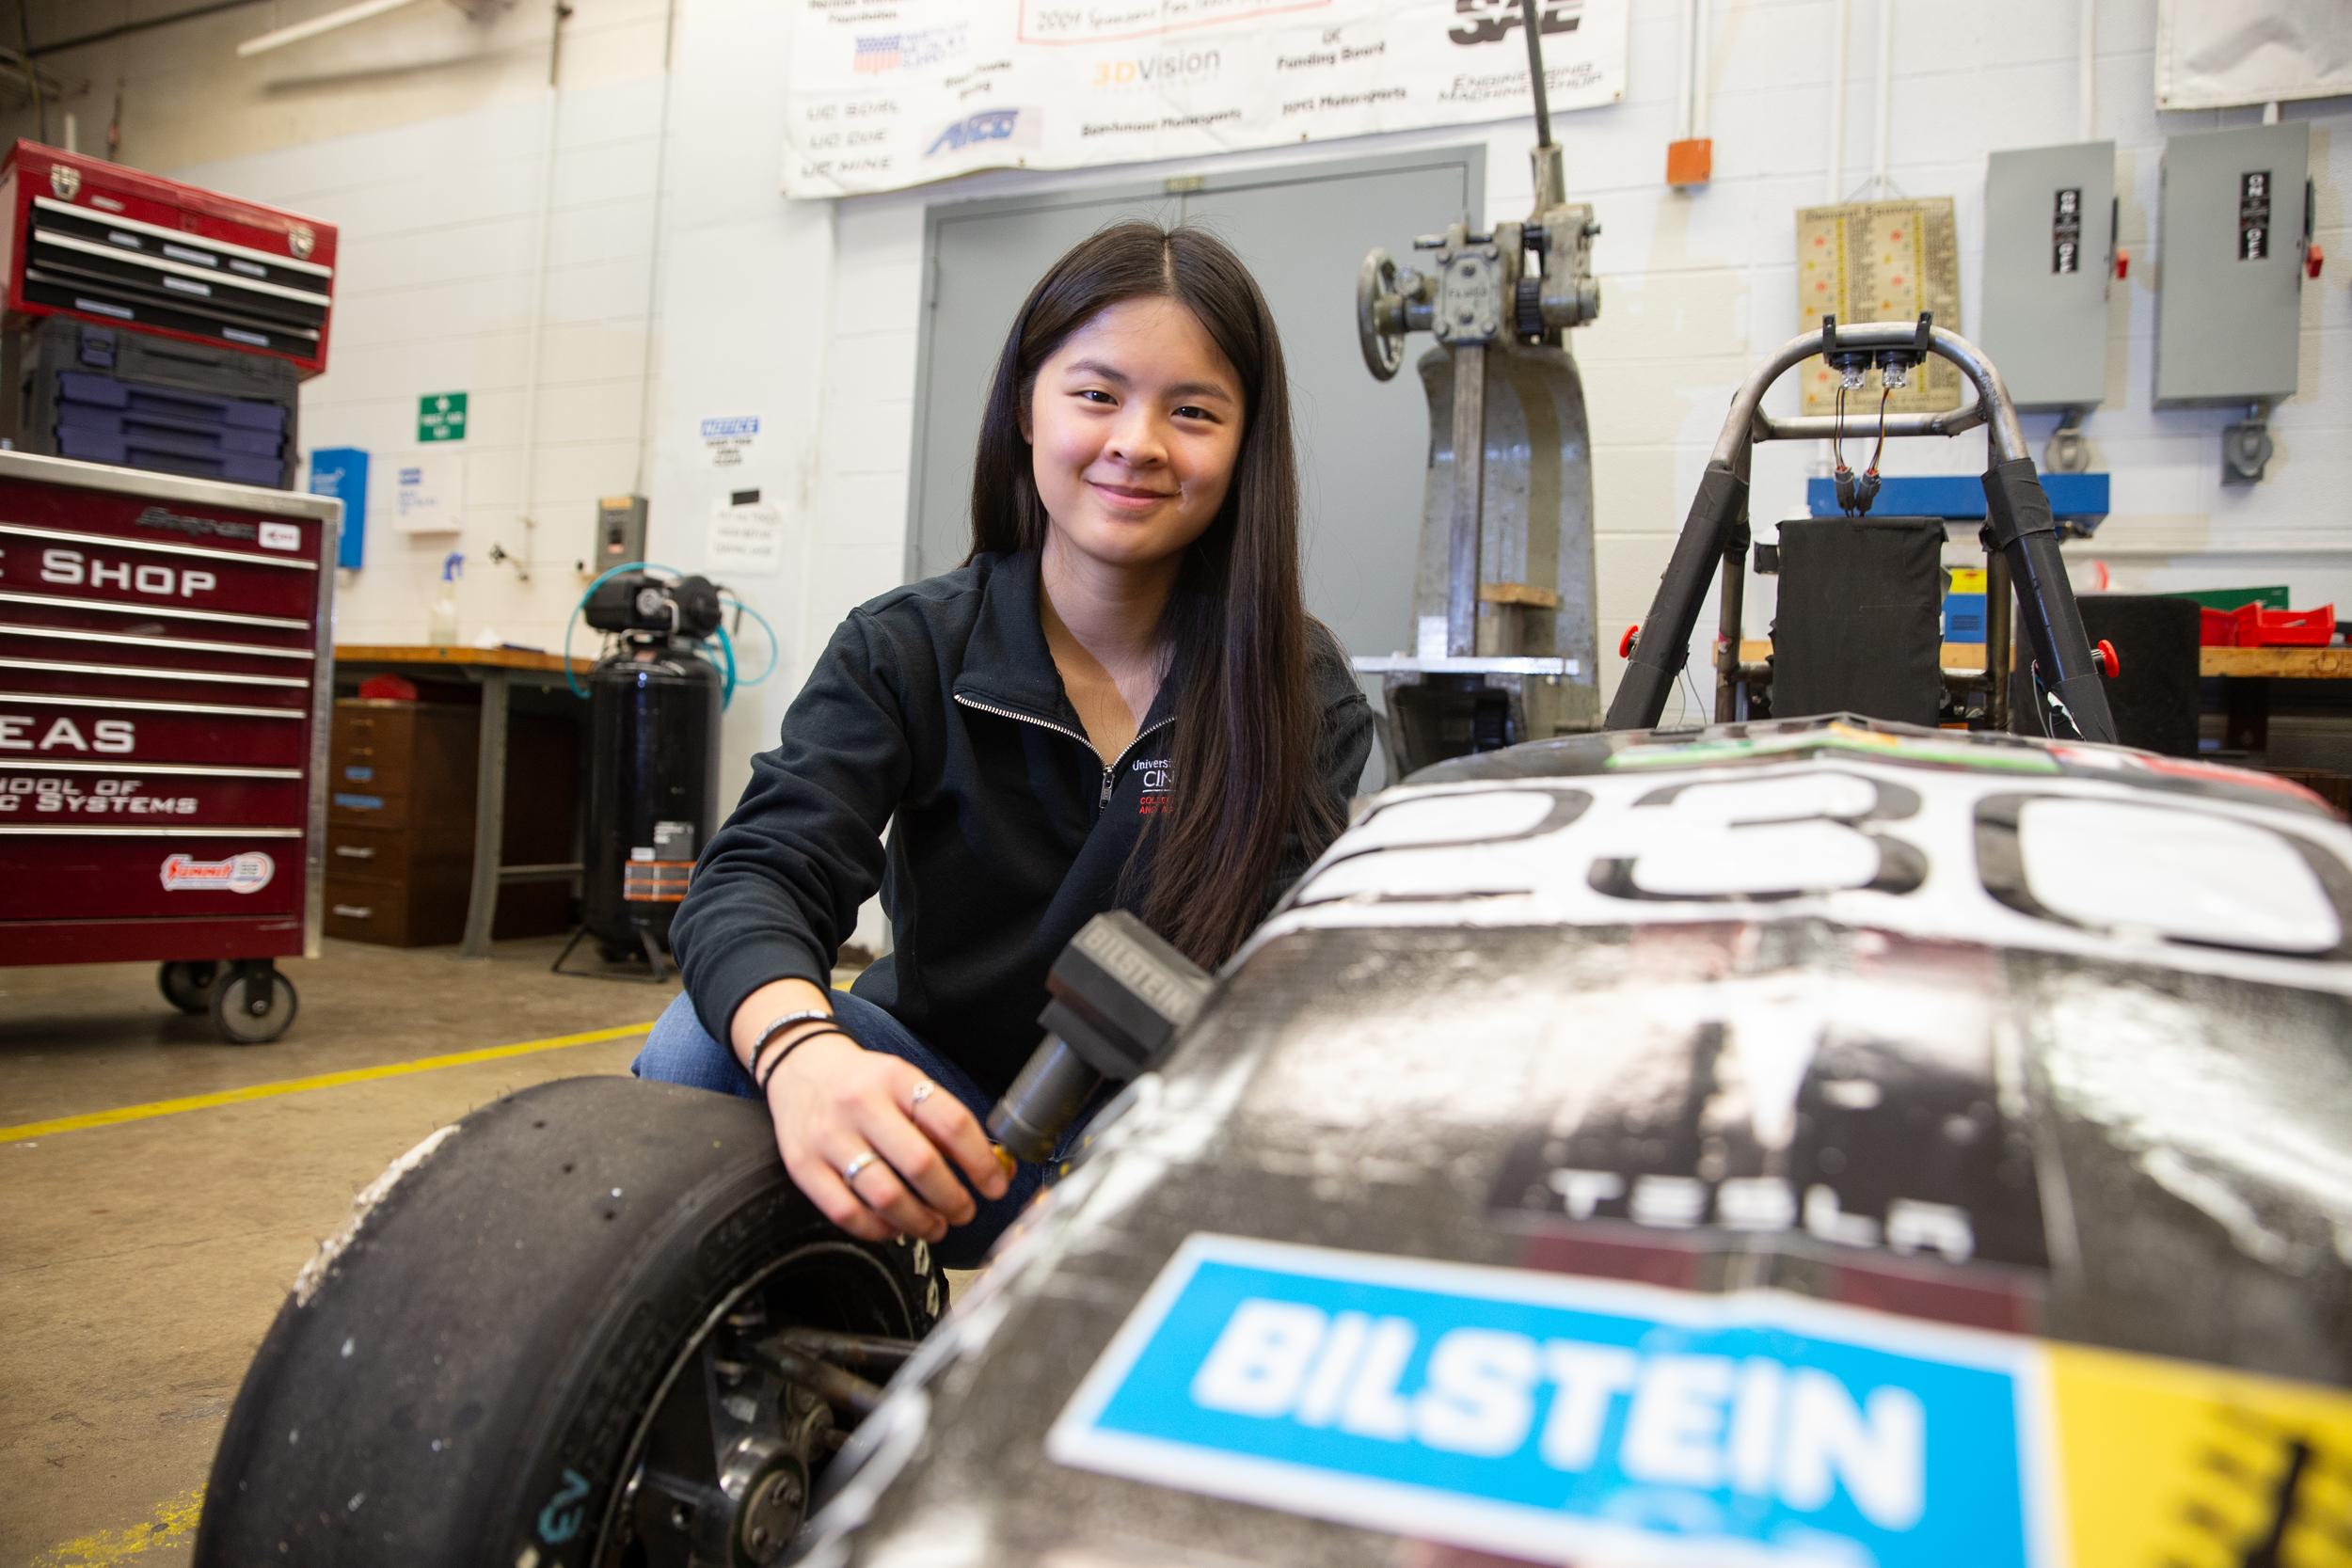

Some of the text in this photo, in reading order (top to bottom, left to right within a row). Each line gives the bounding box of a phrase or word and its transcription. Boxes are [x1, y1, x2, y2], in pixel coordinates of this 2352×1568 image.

[1277, 41, 1387, 71] Funding Board
[41, 548, 216, 597] SHOP
[0, 778, 141, 796] OOL OF
[36, 794, 199, 815] SYSTEMS
[1548, 1167, 1975, 1264] TESLA
[1187, 1296, 1927, 1533] BILSTEIN
